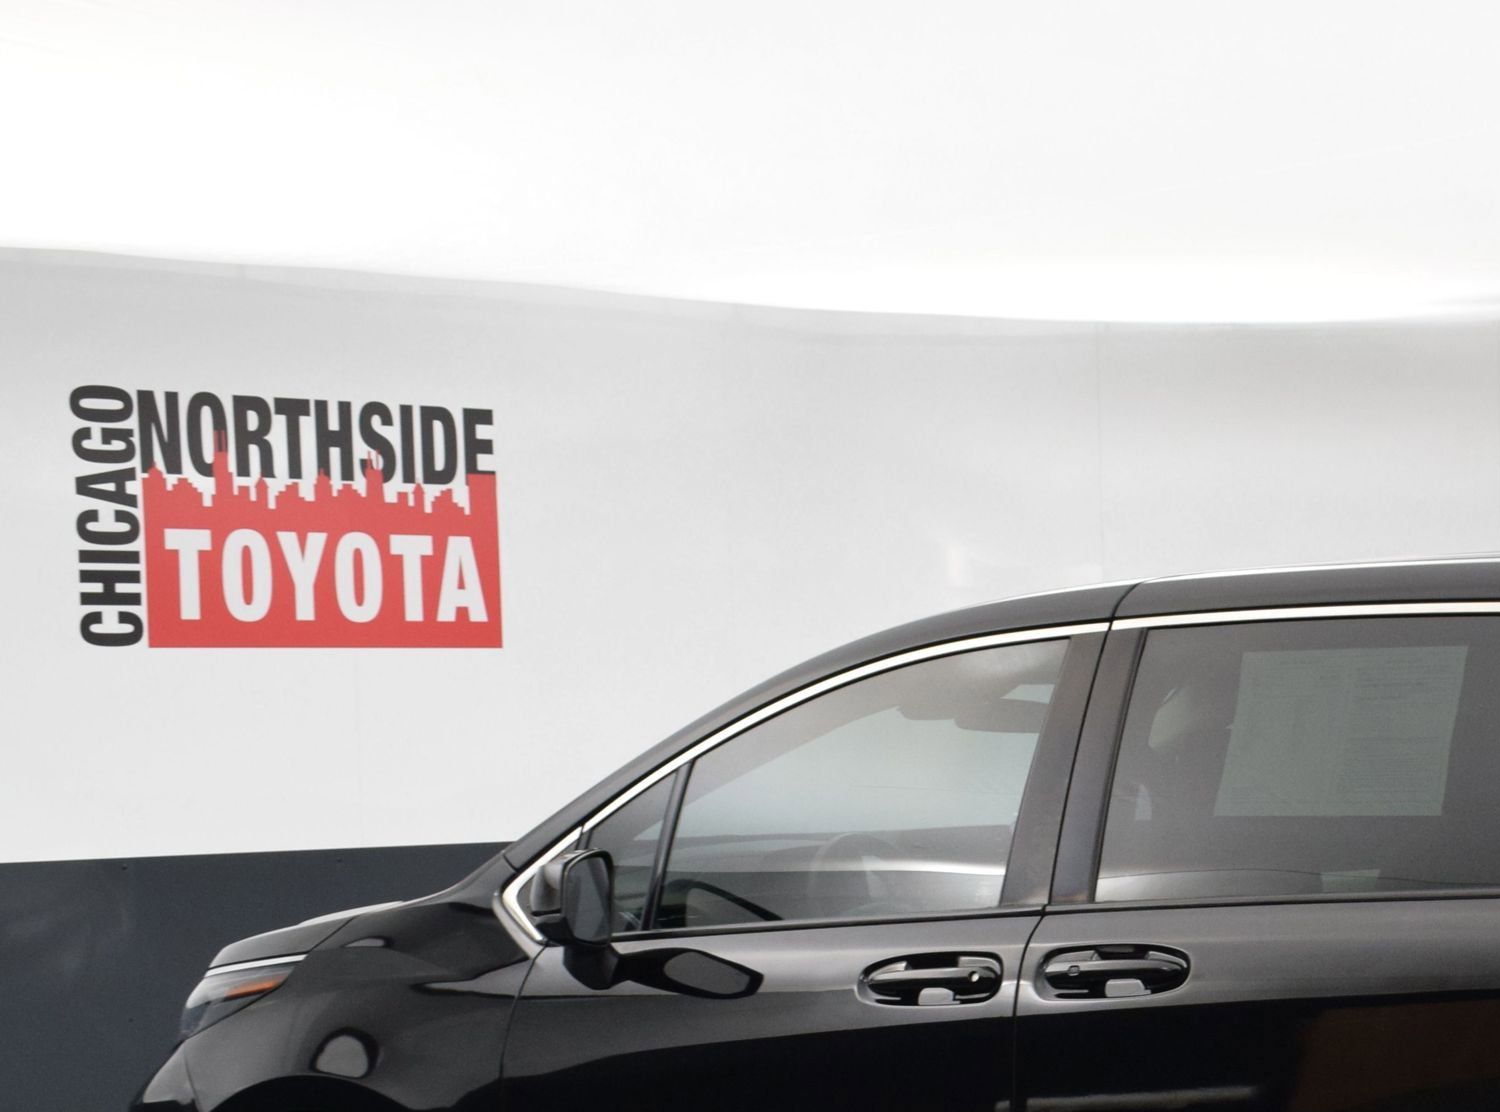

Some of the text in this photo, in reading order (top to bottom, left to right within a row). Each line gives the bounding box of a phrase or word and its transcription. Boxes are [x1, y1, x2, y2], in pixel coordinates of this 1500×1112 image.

[136, 388, 496, 486] NORTHSIDE
[69, 384, 144, 648] CHICAGO
[163, 527, 489, 624] TOYOTA
